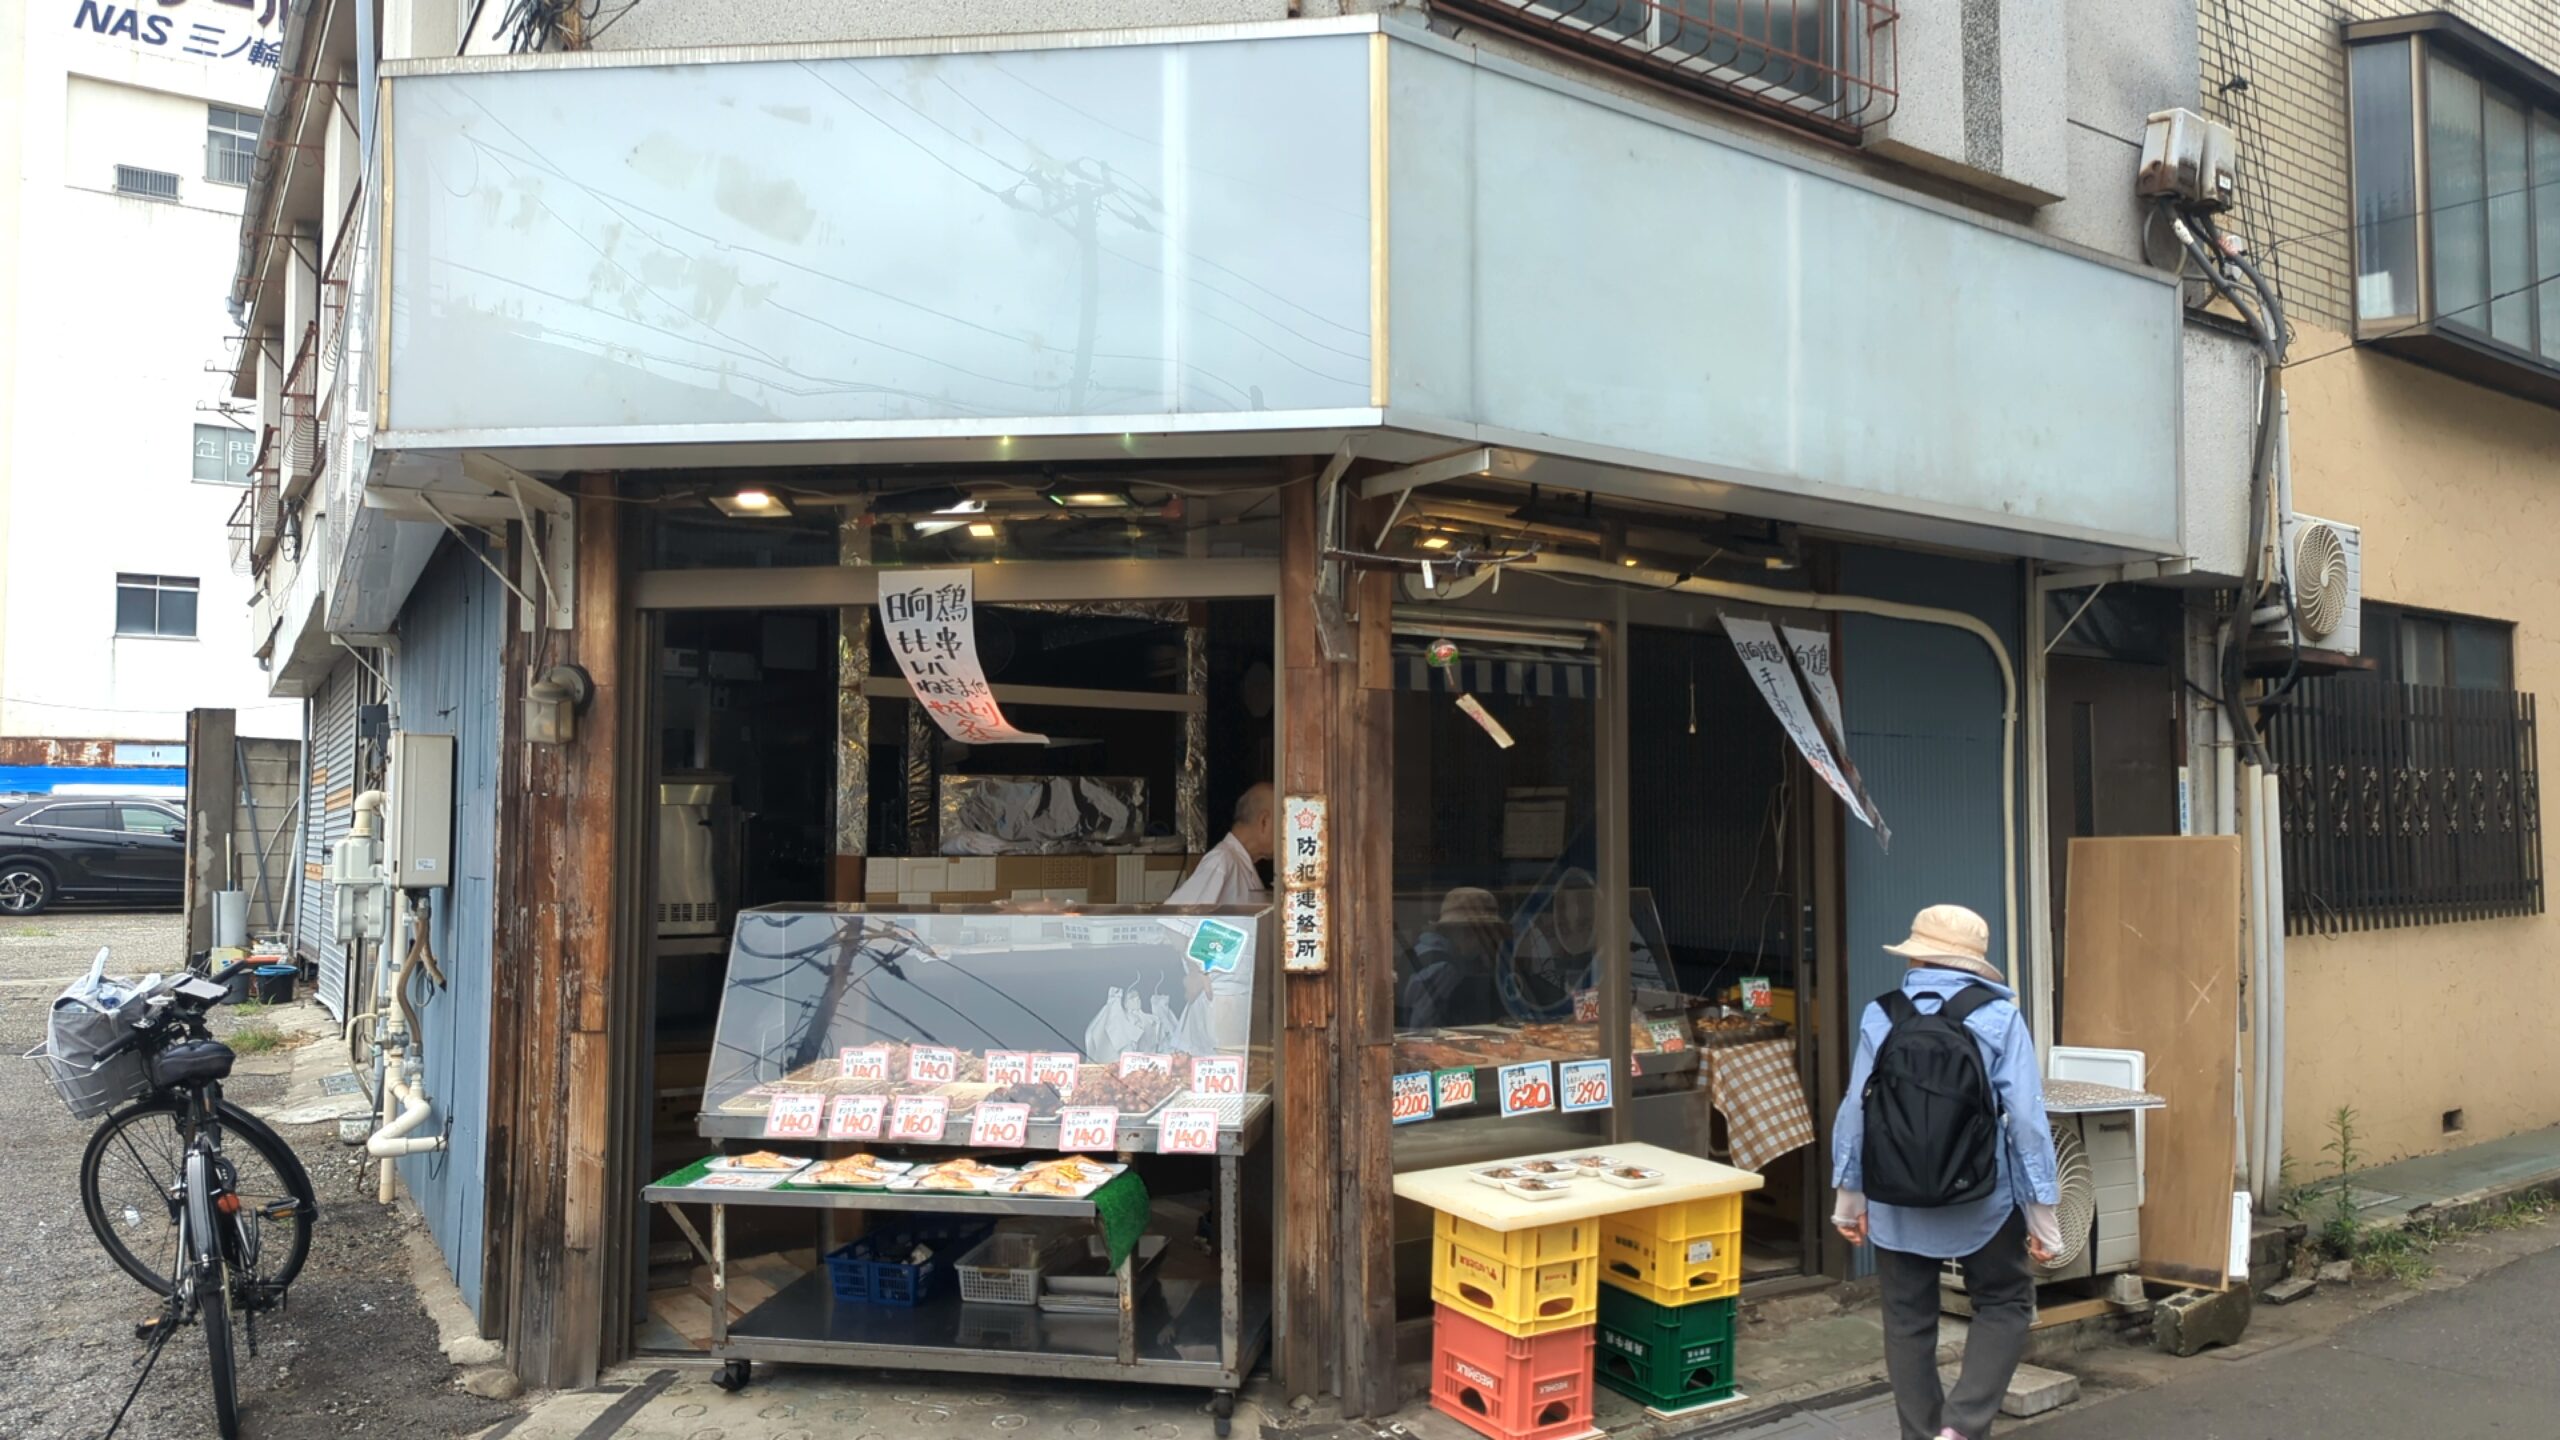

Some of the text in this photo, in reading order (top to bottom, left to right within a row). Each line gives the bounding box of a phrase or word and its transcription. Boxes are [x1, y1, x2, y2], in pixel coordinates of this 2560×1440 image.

[73, 0, 173, 46] NAS
[886, 584, 968, 623] 日向鶏
[897, 626, 962, 660] もも串
[928, 700, 999, 727] やきとり
[1296, 836, 1317, 959] 防犯連絡所
[919, 1061, 949, 1080] 140
[995, 1069, 1021, 1085] 140
[1039, 1069, 1068, 1087] 140
[1205, 1075, 1234, 1093] 140
[1443, 1082, 1472, 1102] 220
[1575, 1081, 1604, 1104] 290
[1509, 1082, 1551, 1111] 620
[779, 1114, 812, 1132] 140
[842, 1114, 872, 1132] 140
[902, 1114, 934, 1132] 160
[982, 1123, 1016, 1141] 140
[1072, 1128, 1106, 1147] 140
[1173, 1130, 1206, 1149] 140
[1456, 1362, 1494, 1389] MEGMILK
